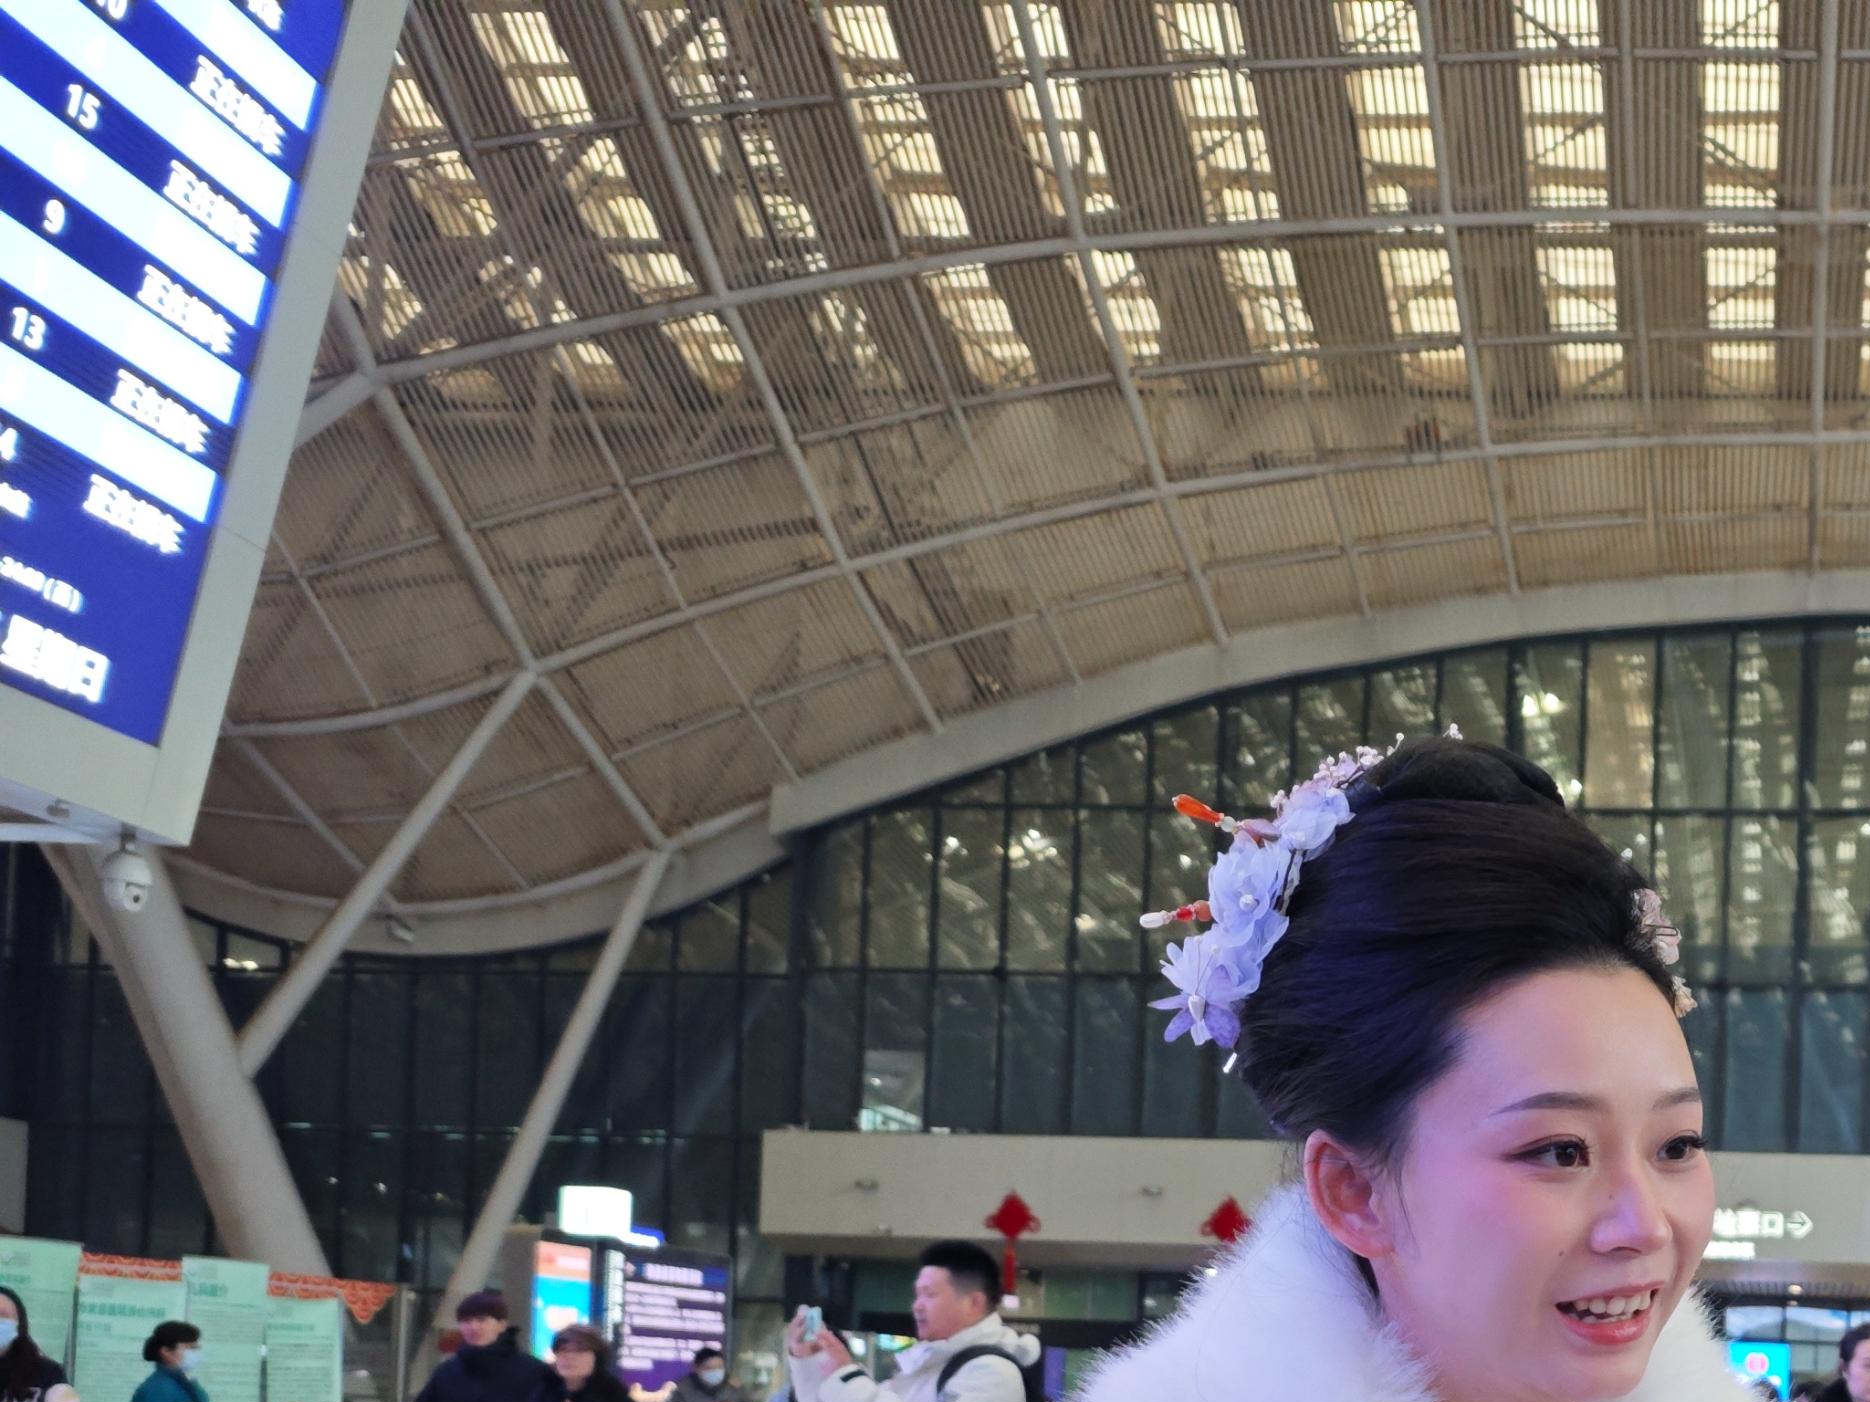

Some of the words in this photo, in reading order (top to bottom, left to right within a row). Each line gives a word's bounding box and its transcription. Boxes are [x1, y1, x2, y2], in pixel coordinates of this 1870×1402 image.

[66, 83, 101, 130] 15
[43, 199, 66, 235] 9
[11, 306, 47, 350] 13
